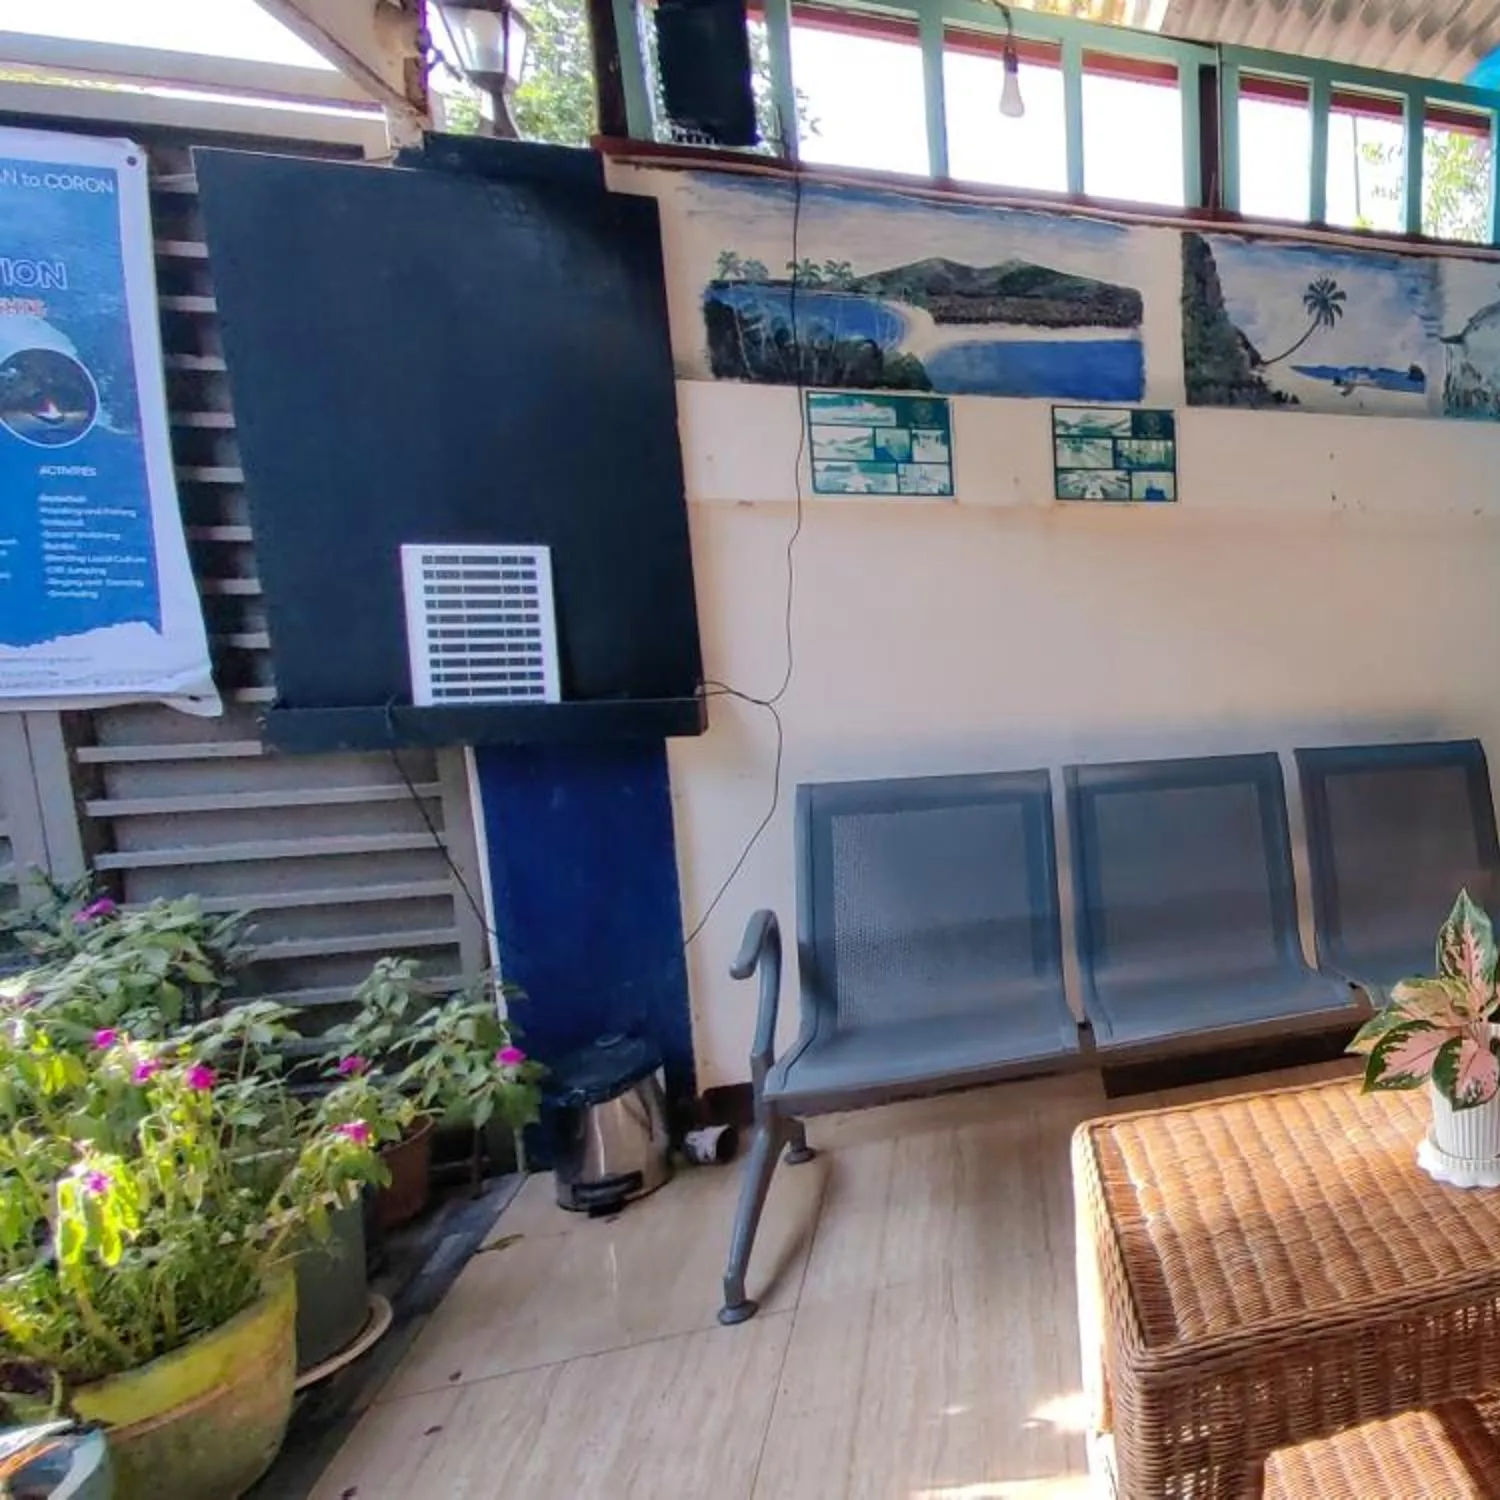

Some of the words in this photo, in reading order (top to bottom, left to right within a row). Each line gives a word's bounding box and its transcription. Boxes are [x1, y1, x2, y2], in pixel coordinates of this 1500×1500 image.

[21, 172, 40, 187] to
[44, 172, 114, 193] CORON
[0, 257, 68, 291] ION
